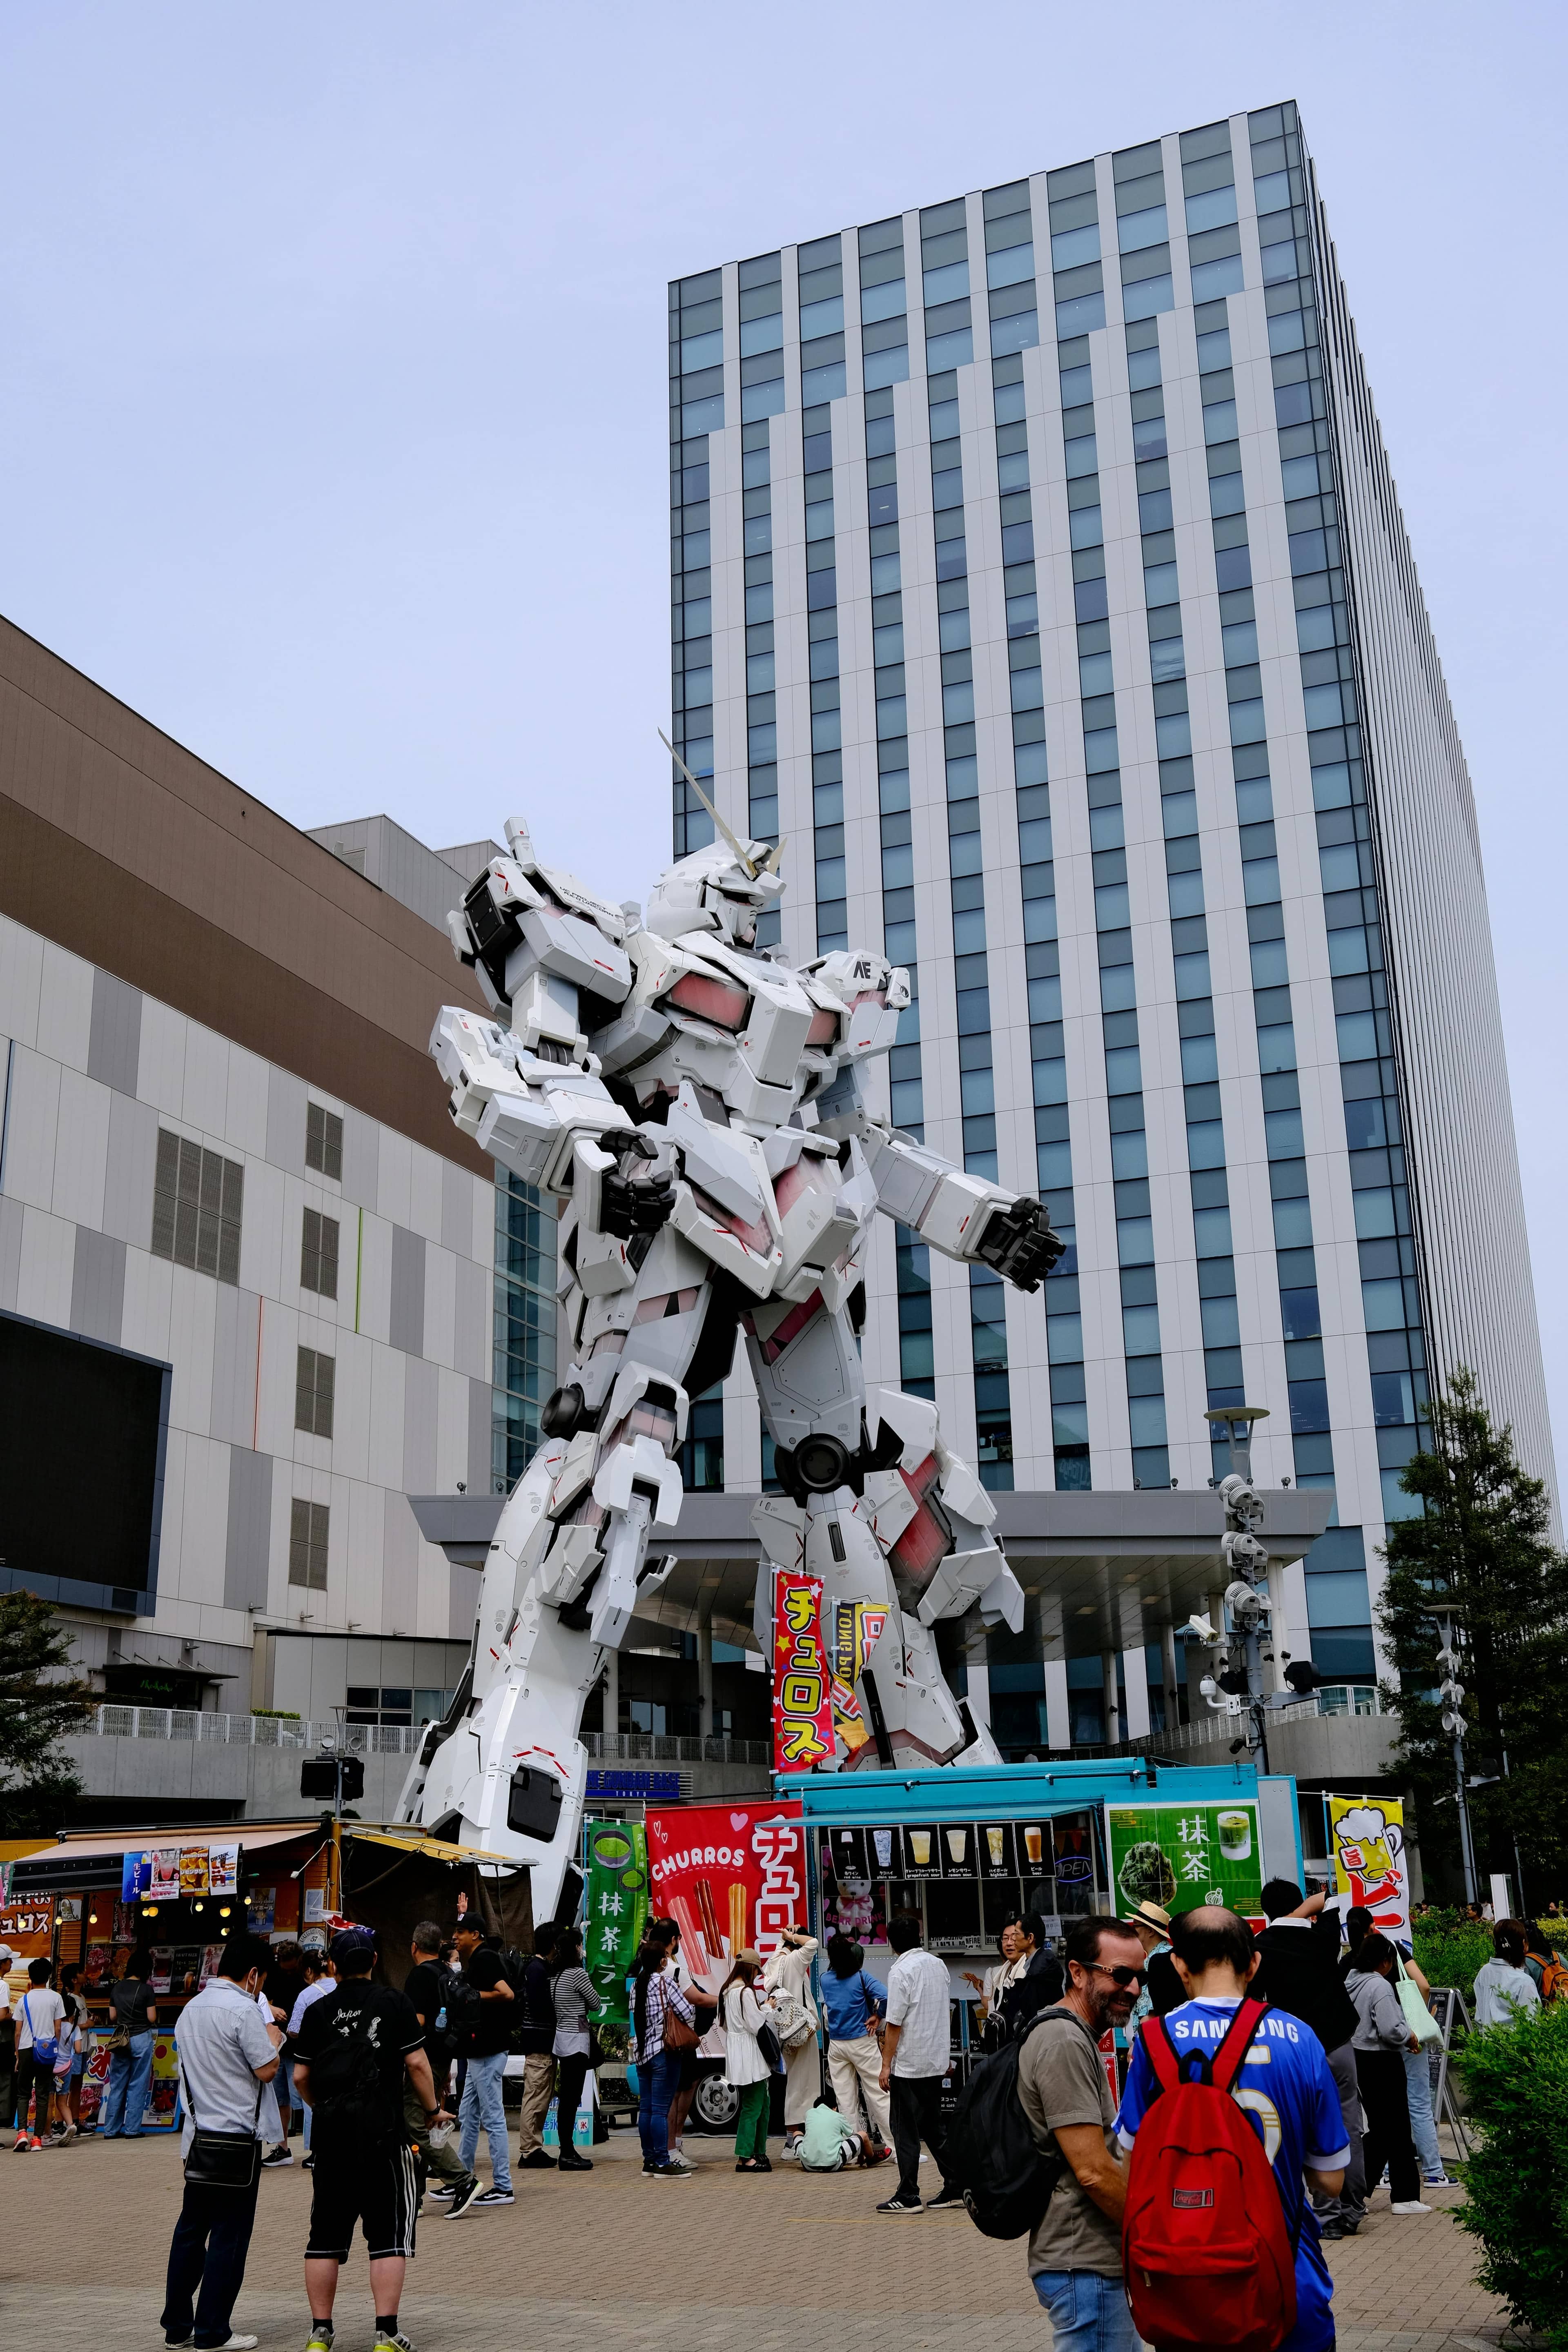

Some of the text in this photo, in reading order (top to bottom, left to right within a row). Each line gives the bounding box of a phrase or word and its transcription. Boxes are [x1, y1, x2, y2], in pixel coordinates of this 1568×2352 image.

[572, 893, 607, 910] PROJECT
[582, 900, 613, 917] UNICORN
[780, 1586, 829, 1763] チュロス
[587, 1770, 680, 1790] HE GUNDAM BASE
[211, 1852, 229, 1862] DRINK
[1176, 1815, 1211, 1881] 抹茶
[1344, 1849, 1362, 1866] 旨
[652, 1846, 745, 1881] CHURROS
[132, 1863, 141, 1894] 生ビール
[0, 1913, 49, 1934] ュロス
[826, 1911, 884, 1927] BEAR DRINK
[597, 1891, 624, 2017] 抹茶ラテ
